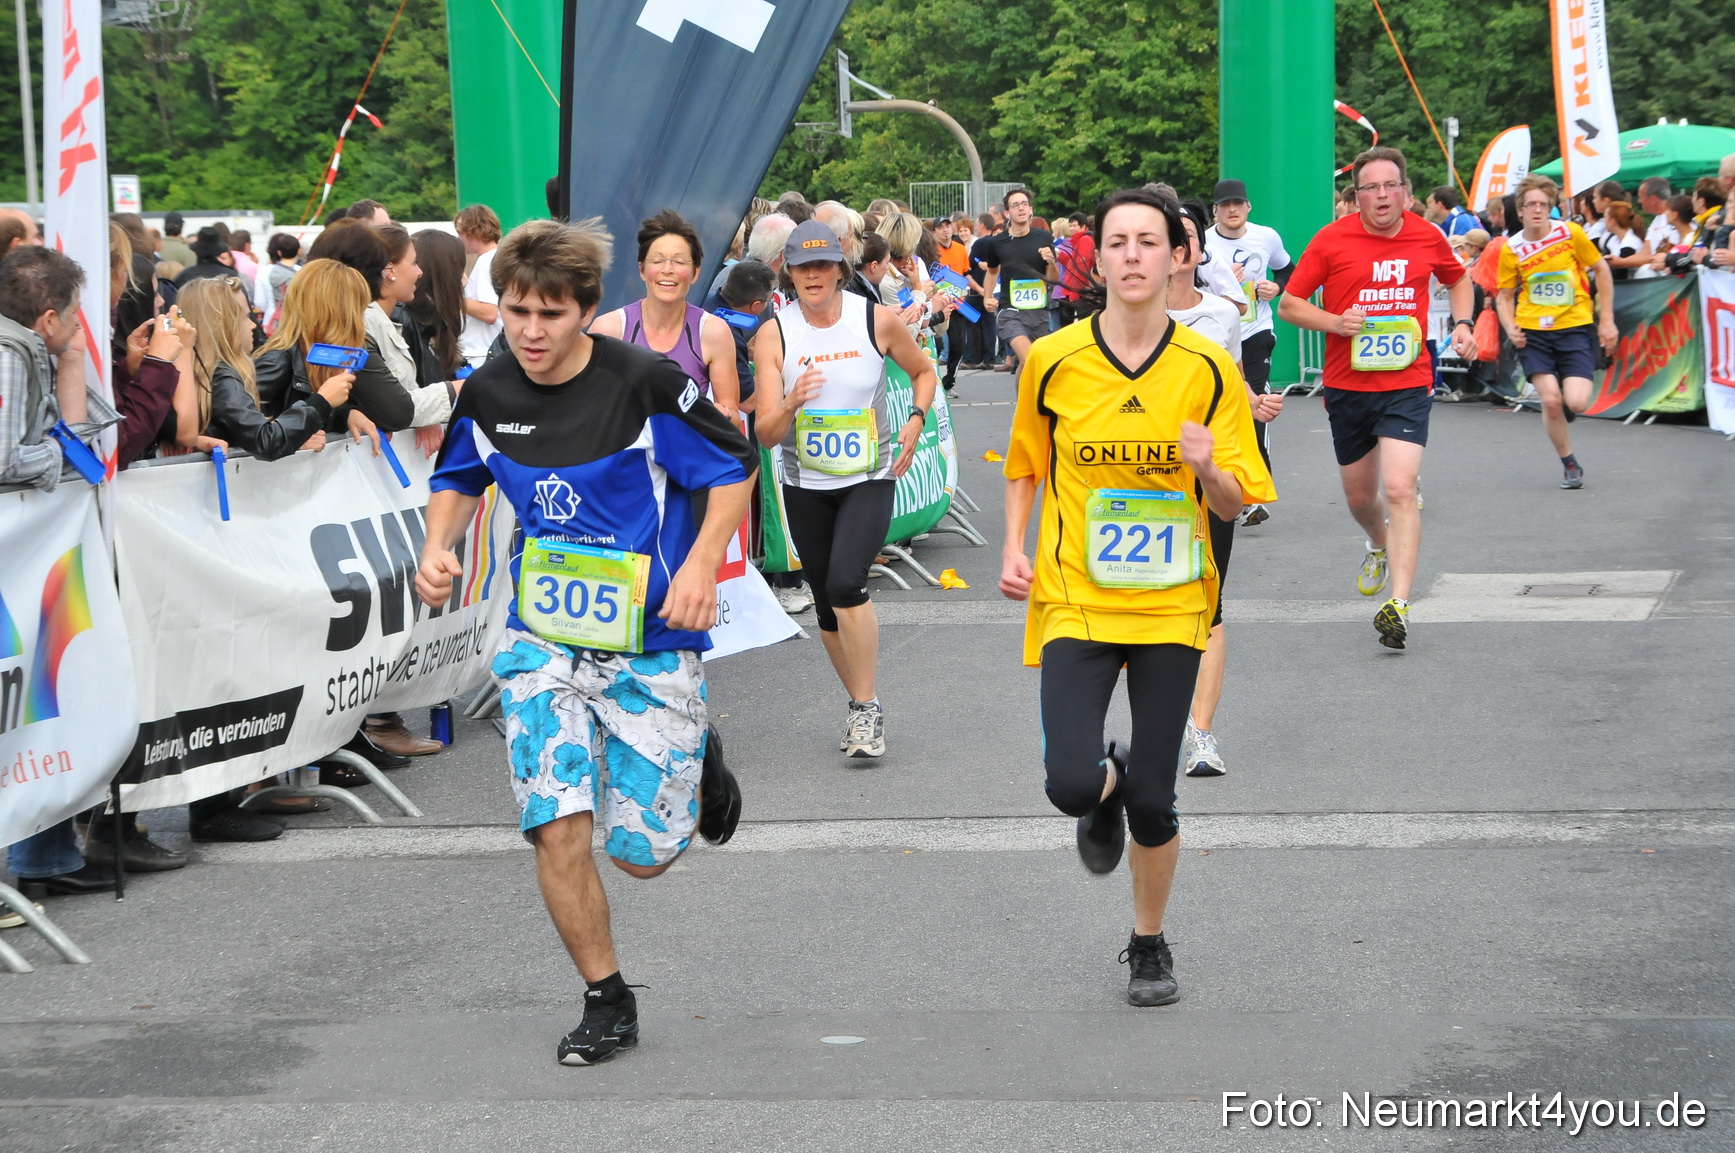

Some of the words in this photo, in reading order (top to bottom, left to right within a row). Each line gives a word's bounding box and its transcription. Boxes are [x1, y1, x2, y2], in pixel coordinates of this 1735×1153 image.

[802, 239, 828, 249] OBI
[1372, 258, 1409, 286] MRT
[1014, 289, 1039, 302] 246
[1359, 287, 1415, 301] MEIER
[1533, 283, 1565, 297] 459
[1352, 302, 1394, 312] Running
[1394, 301, 1417, 310] Team
[1359, 334, 1406, 357] 256
[814, 350, 863, 363] KLEBL
[496, 422, 536, 435] saller
[806, 432, 861, 458] 506
[1079, 445, 1176, 463] ONLINE
[1136, 465, 1181, 476] Germany
[1097, 523, 1174, 563] 221
[1106, 564, 1132, 573] Anita
[534, 575, 618, 624] 305
[551, 617, 582, 630] Silvan
[143, 736, 188, 766] Leistung,
[189, 726, 214, 751] die
[217, 712, 286, 745] verbinden
